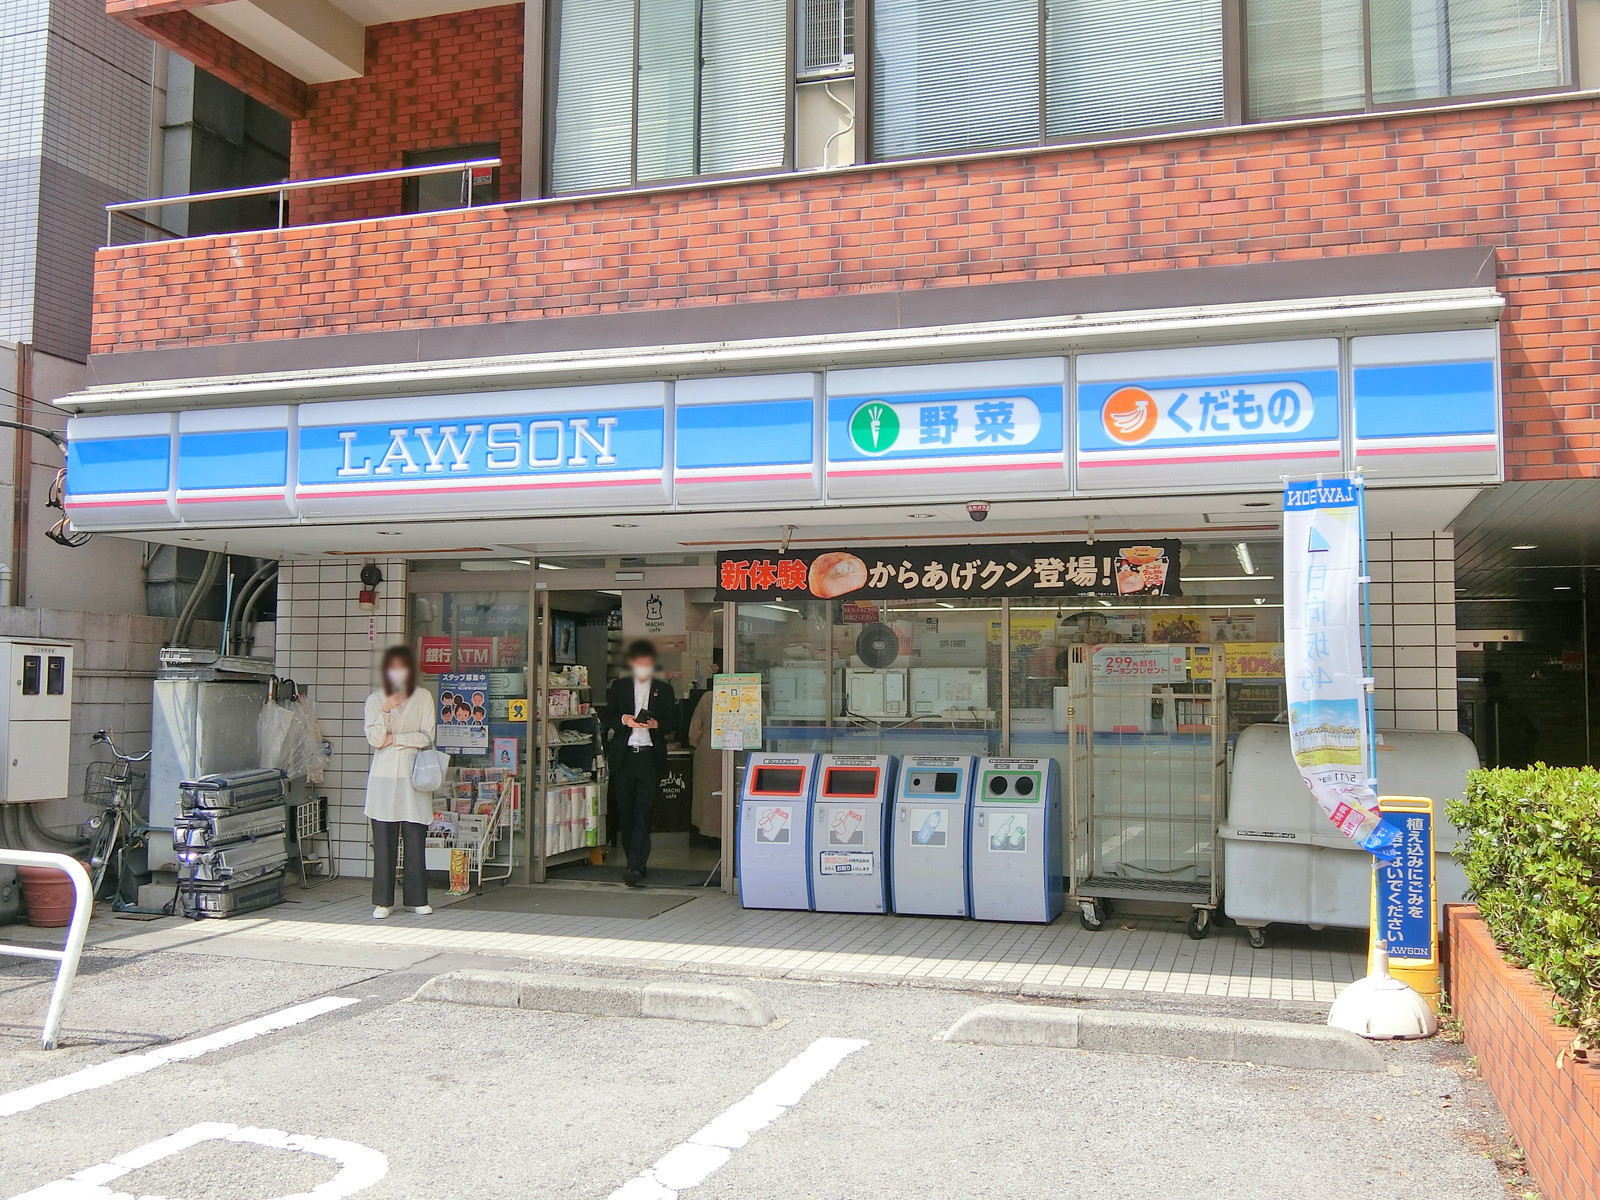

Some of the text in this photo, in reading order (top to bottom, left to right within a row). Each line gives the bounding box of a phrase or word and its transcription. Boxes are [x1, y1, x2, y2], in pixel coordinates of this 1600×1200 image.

[918, 402, 1016, 446] 野菜
[1166, 388, 1302, 433] くだもの
[336, 415, 618, 478] LAWSON
[720, 559, 808, 591] 新体験
[868, 555, 1112, 591] からあげクン登場!
[442, 673, 486, 681] スタッフ募集中
[1105, 667, 1168, 675] クーポンプレゼント
[1386, 831, 1404, 942] ないでください
[1406, 817, 1425, 919] 植え込みにごみを
[1387, 947, 1429, 956] AWSON
